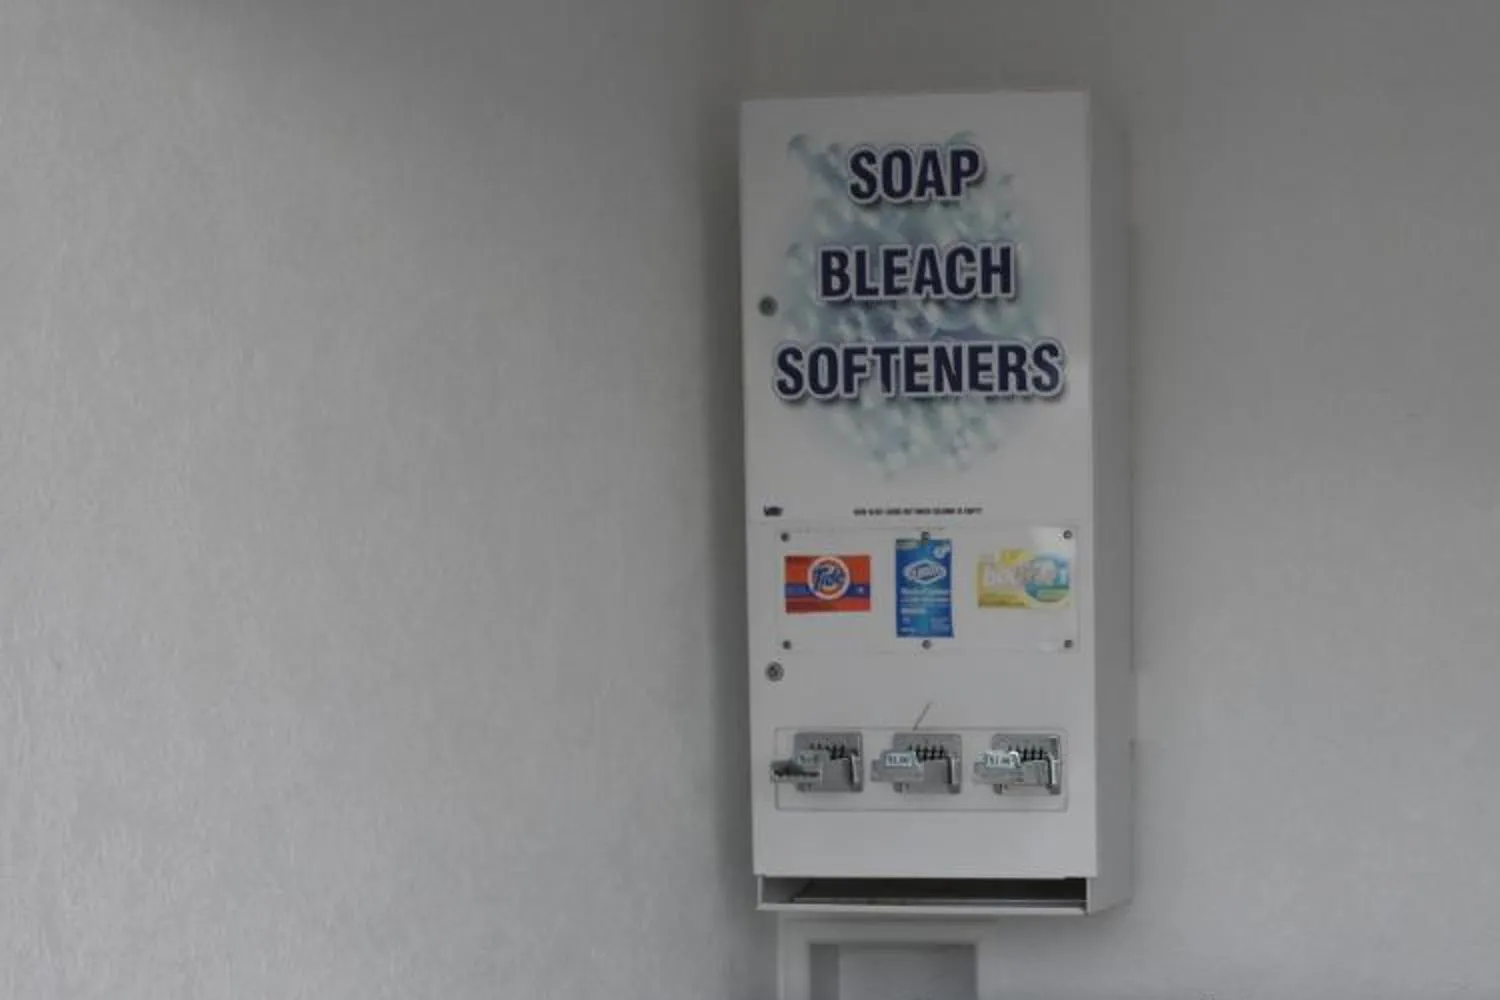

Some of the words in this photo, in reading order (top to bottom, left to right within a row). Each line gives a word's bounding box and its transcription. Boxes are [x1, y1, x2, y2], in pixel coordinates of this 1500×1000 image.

[849, 147, 981, 200] SOAP
[819, 245, 1013, 298] BLEACH
[776, 342, 1061, 396] SOFTENERS
